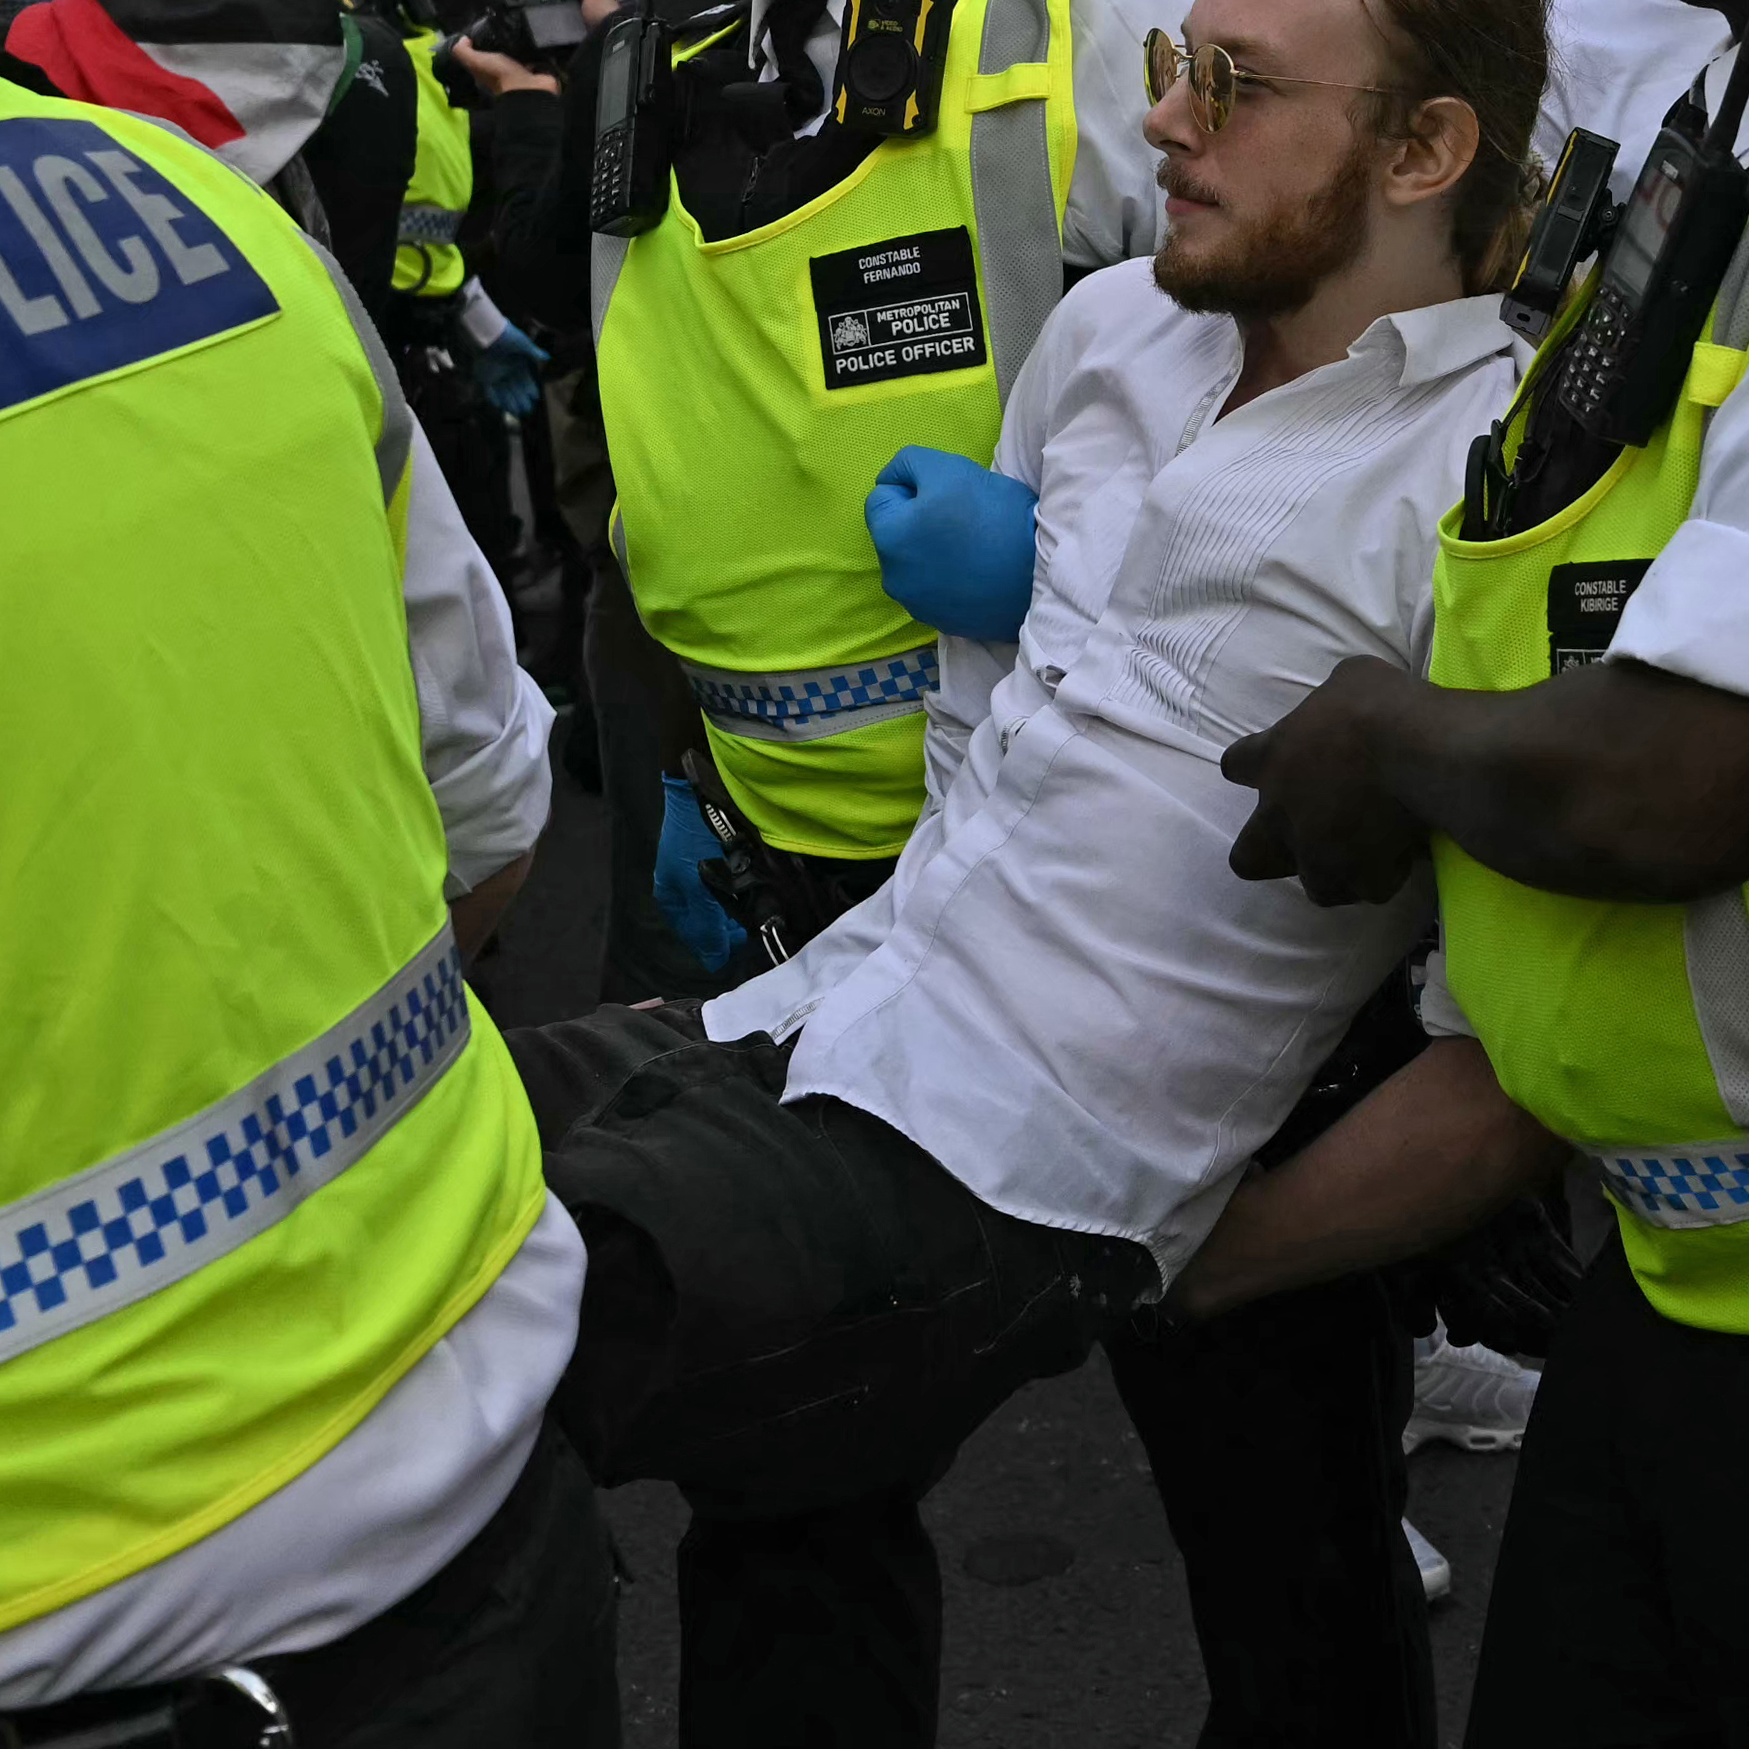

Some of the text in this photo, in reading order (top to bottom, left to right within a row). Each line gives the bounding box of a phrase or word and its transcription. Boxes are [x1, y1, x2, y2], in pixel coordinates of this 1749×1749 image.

[862, 107, 886, 116] AXON
[858, 246, 921, 269] CONSTABLE
[863, 262, 921, 284] FERNANDO
[876, 299, 960, 323] METROPOLITAN
[891, 312, 951, 336] POLICE
[835, 336, 975, 374] POLICE OFFICER
[1574, 579, 1627, 596] CONSTABLE
[1580, 597, 1619, 612] KIBIRIGE
